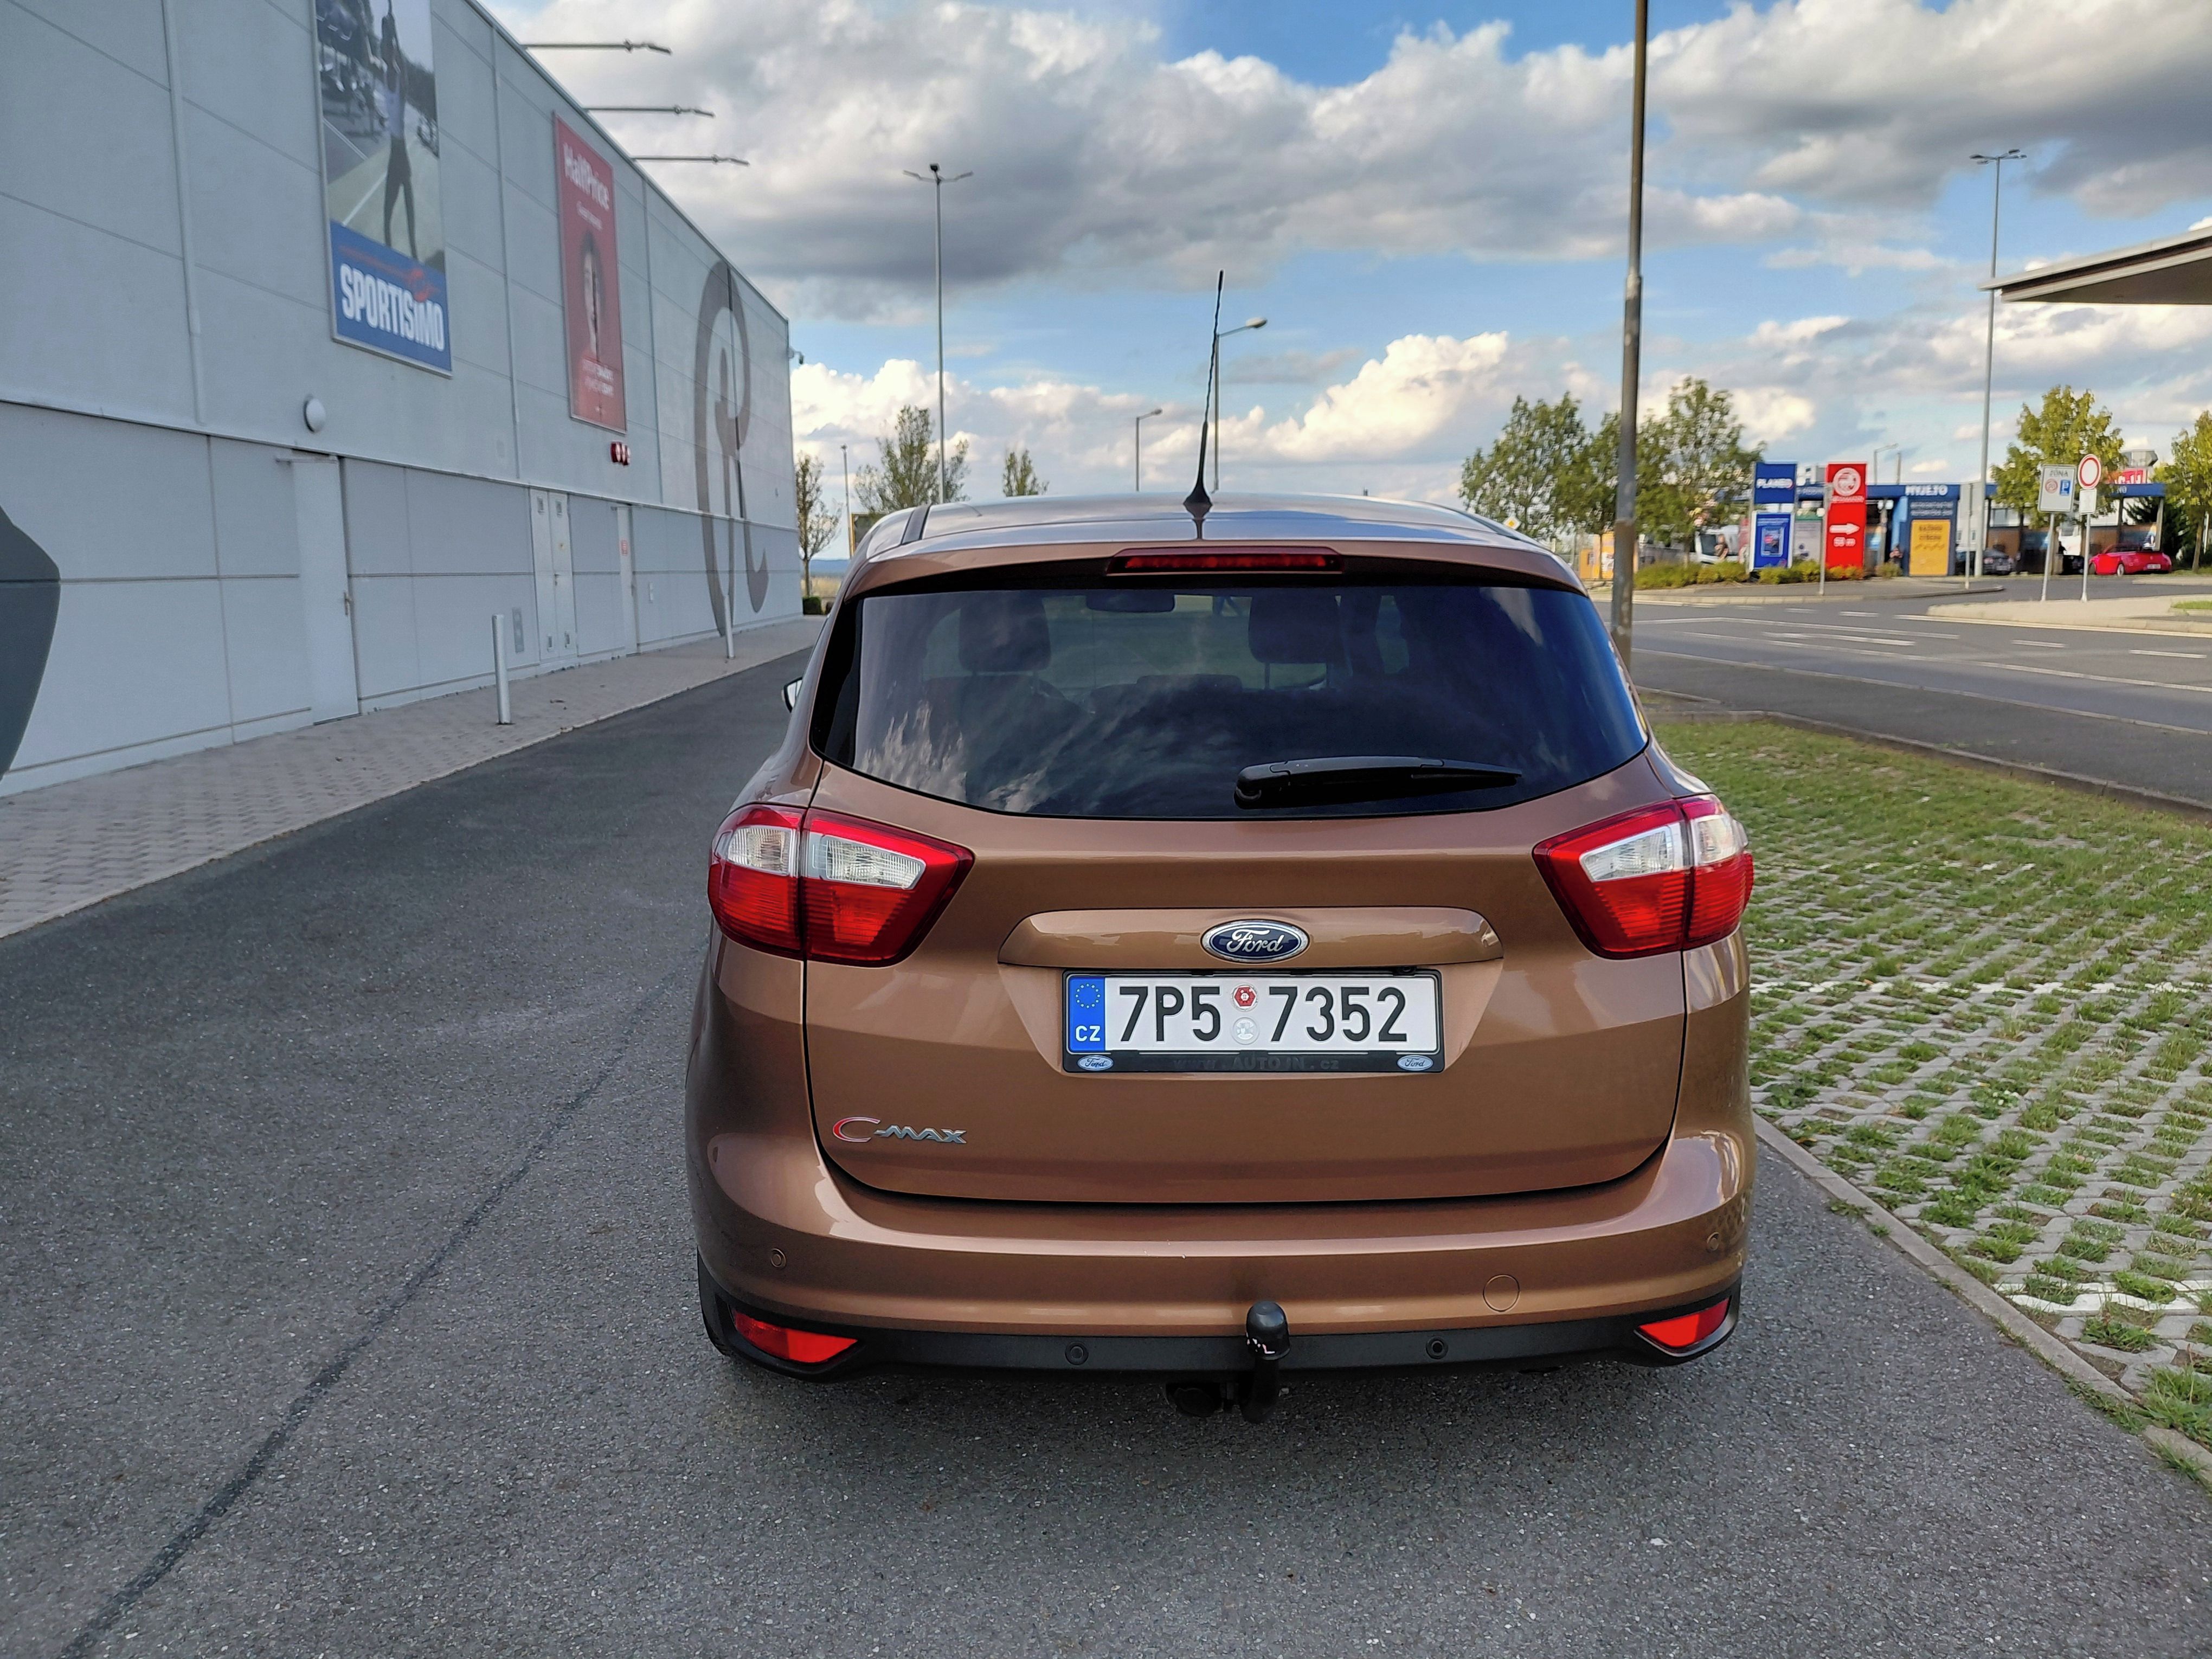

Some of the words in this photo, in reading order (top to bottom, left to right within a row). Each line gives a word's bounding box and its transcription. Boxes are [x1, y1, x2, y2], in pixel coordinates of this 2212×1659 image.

[340, 263, 445, 352] SPORTISIMO
[1226, 929, 1284, 953] Ford
[1120, 986, 1220, 1041] 7P5
[1269, 986, 1407, 1042] 7352
[1076, 1025, 1101, 1041] CZ
[1084, 1058, 1106, 1068] Ford
[1404, 1058, 1425, 1068] Ford
